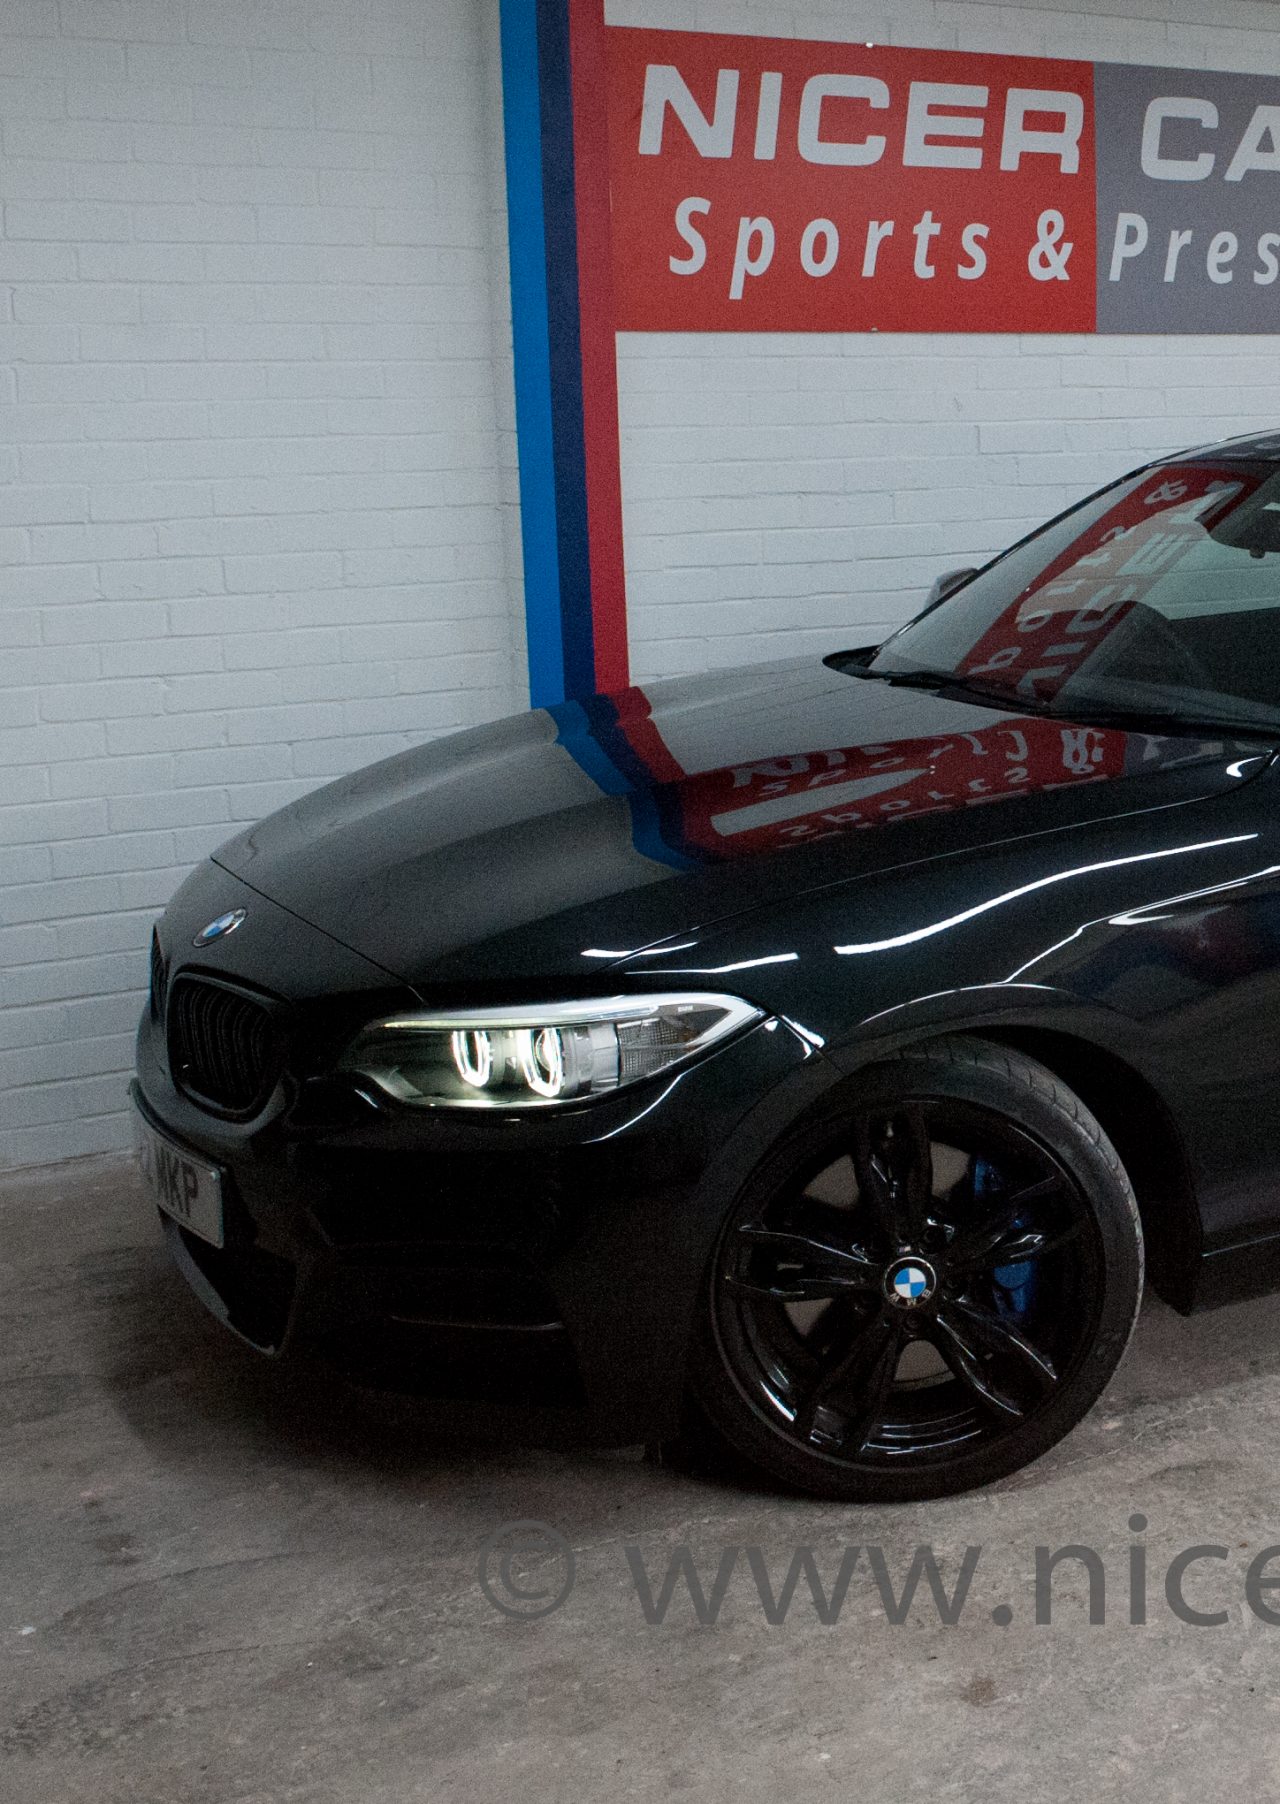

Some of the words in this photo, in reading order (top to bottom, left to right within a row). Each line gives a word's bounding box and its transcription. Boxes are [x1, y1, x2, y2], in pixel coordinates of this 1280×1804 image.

[638, 63, 1085, 175] NICER
[669, 196, 990, 300] Sports
[1027, 209, 1075, 283] &
